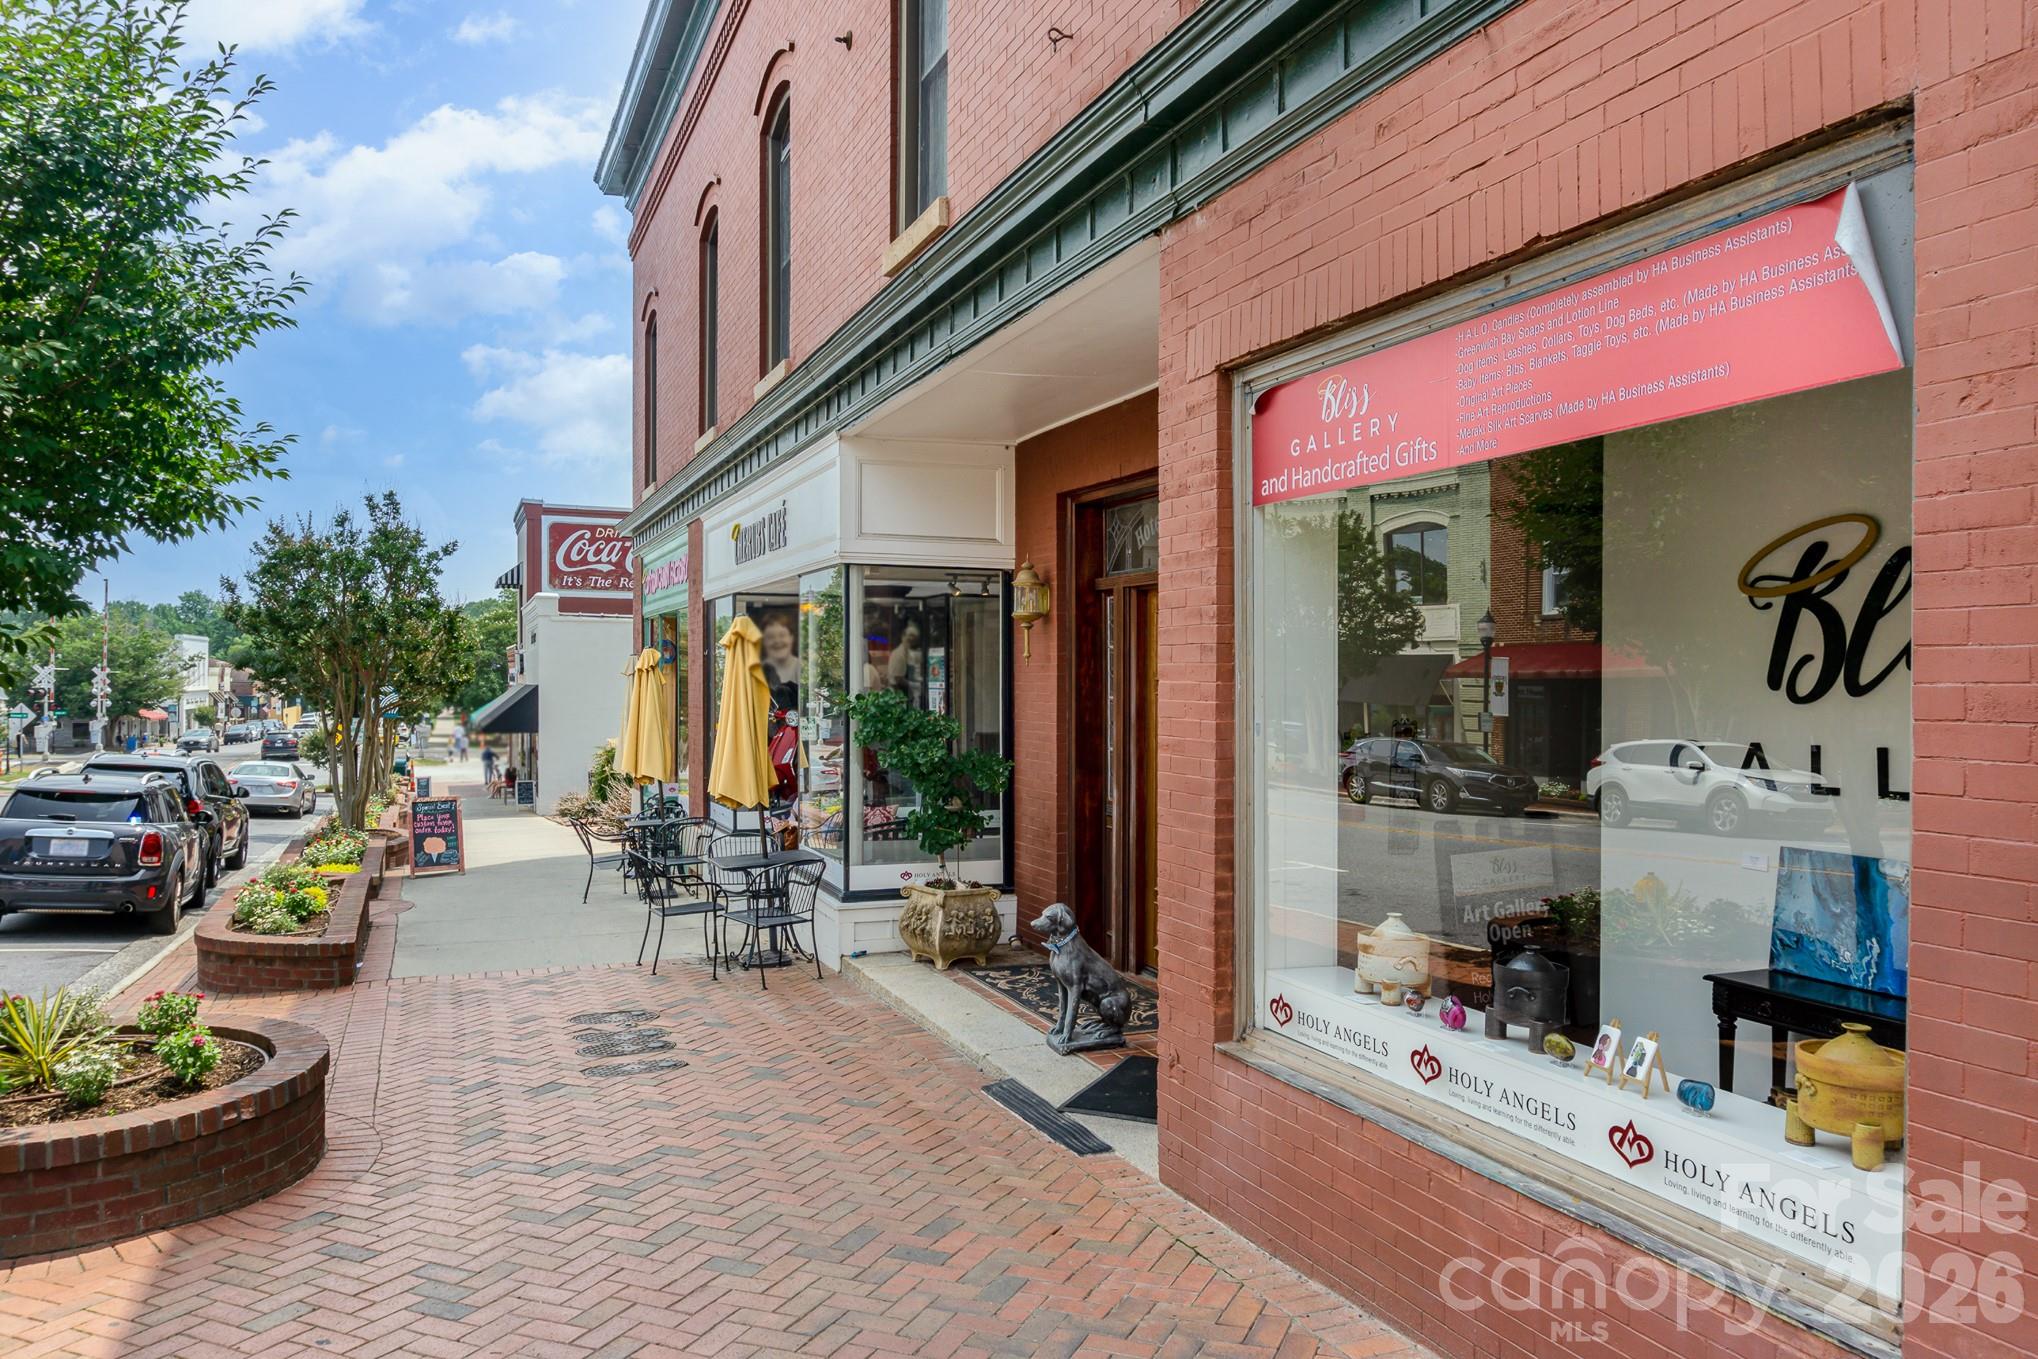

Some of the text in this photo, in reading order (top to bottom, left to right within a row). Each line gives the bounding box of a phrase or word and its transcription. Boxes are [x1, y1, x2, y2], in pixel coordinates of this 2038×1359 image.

[1492, 311, 1525, 331] Candles
[1527, 291, 1579, 321] (Completely
[1582, 272, 1634, 300] assembled
[1637, 268, 1649, 284] by
[1652, 260, 1668, 277] HA
[1671, 242, 1722, 271] Business
[1724, 217, 1793, 252] Assistants)
[1606, 314, 1626, 330] Dog
[1660, 297, 1680, 312] etc.
[1683, 283, 1718, 309] (Made
[1722, 278, 1735, 297] by
[1740, 272, 1758, 288] HA
[1762, 252, 1819, 281] Business
[1501, 332, 1516, 346] Bay
[1519, 323, 1545, 339] Soaps
[1547, 315, 1563, 330] and
[1566, 305, 1596, 324] Lotion
[1599, 297, 1620, 314] Line
[1633, 325, 1652, 340] etc.
[1655, 312, 1689, 336] (Made
[1692, 309, 1706, 324] by
[1709, 301, 1727, 317] HA
[1730, 284, 1785, 311] Business
[1319, 377, 1376, 423] Bliss
[1477, 407, 1489, 418] Art
[1491, 391, 1552, 416] Reproductions
[1488, 420, 1502, 433] Silk
[1504, 416, 1518, 429] Art
[1520, 408, 1553, 426] Scarves
[1556, 399, 1584, 418] (Made
[1587, 397, 1599, 410] by
[1601, 390, 1616, 406] HA
[1619, 380, 1665, 401] Business
[1668, 362, 1730, 389] Assistants)
[1491, 387, 1504, 400] Art
[1506, 378, 1533, 393] Pieces
[1290, 412, 1398, 456] GALLERY
[1476, 439, 1497, 452] More
[1261, 436, 1438, 496] and Handcrafted Gifts
[562, 575, 582, 587] It's
[588, 576, 612, 588] The
[1748, 540, 1911, 704] Bl
[1463, 904, 1491, 923] Art
[1489, 923, 1533, 944] Open
[1298, 1010, 1330, 1035] HOLY
[1334, 1024, 1389, 1057] ANGELS
[1449, 1067, 1576, 1131] HOLY ANGELS
[1664, 1150, 1855, 1244] HOLY ANGELS
[1691, 1187, 1711, 1205] living
[1713, 1199, 1727, 1210] and
[1729, 1204, 1760, 1226] learning
[1762, 1217, 1773, 1229] for
[1775, 1223, 1788, 1236] the
[1790, 1230, 1832, 1255] differently
